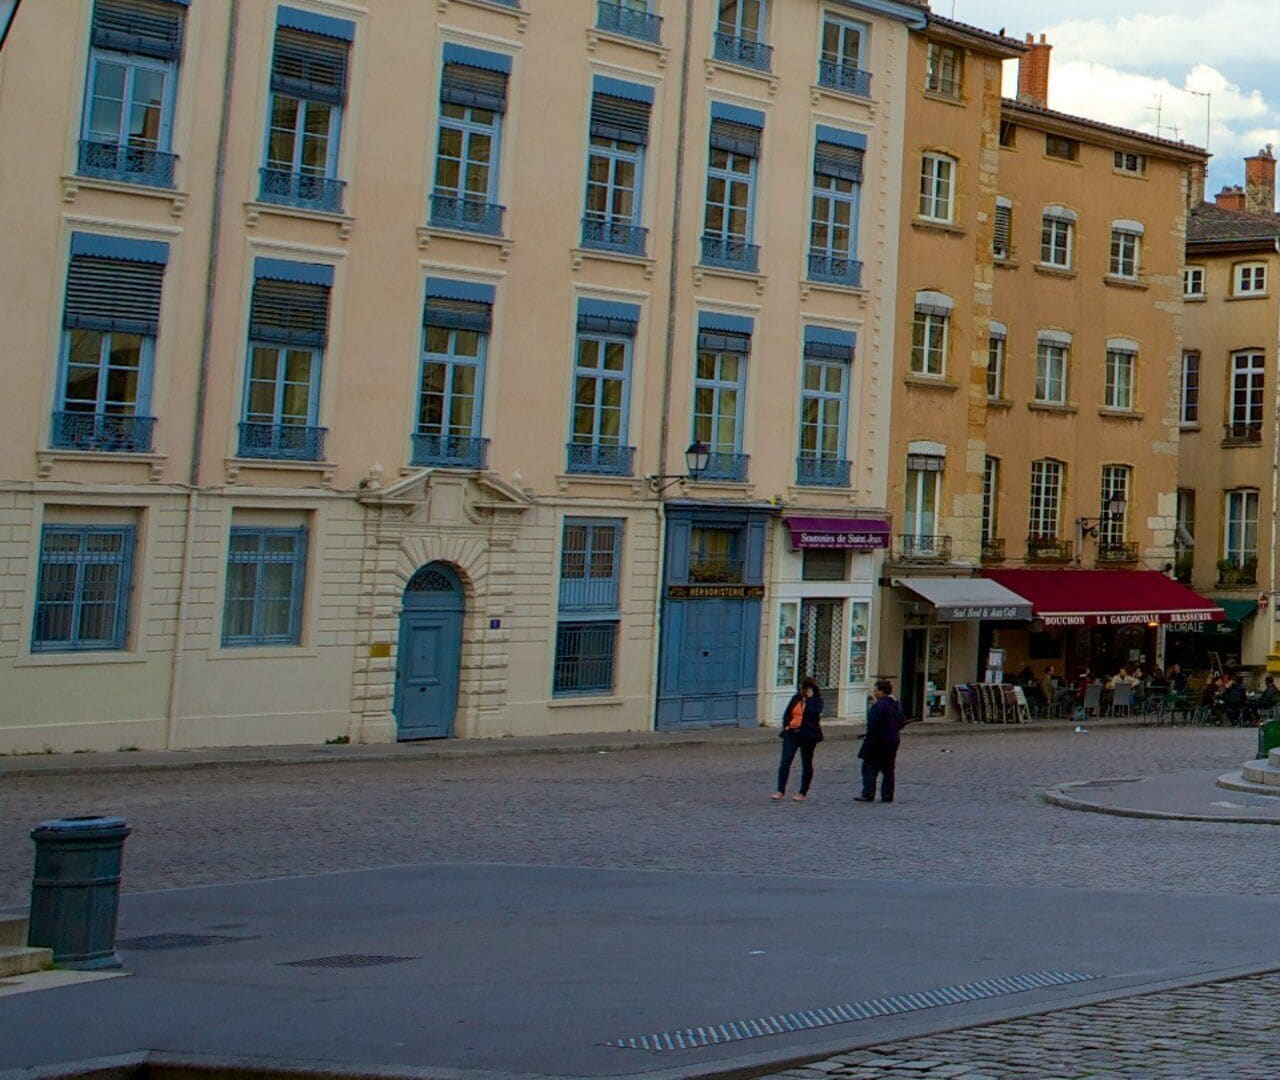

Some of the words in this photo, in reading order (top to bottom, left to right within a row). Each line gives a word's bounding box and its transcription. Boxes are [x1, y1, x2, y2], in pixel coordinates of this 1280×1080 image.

[800, 532, 835, 543] Souvenirs
[836, 534, 846, 543] de
[847, 533, 866, 544] Saint
[690, 587, 745, 597] HERBORISTERIE
[982, 608, 989, 617] &
[1044, 616, 1085, 626] BOUCHON
[1096, 616, 1108, 625] LA
[1110, 614, 1160, 625] GARGOUILLE
[1171, 612, 1213, 622] BRASSERIE
